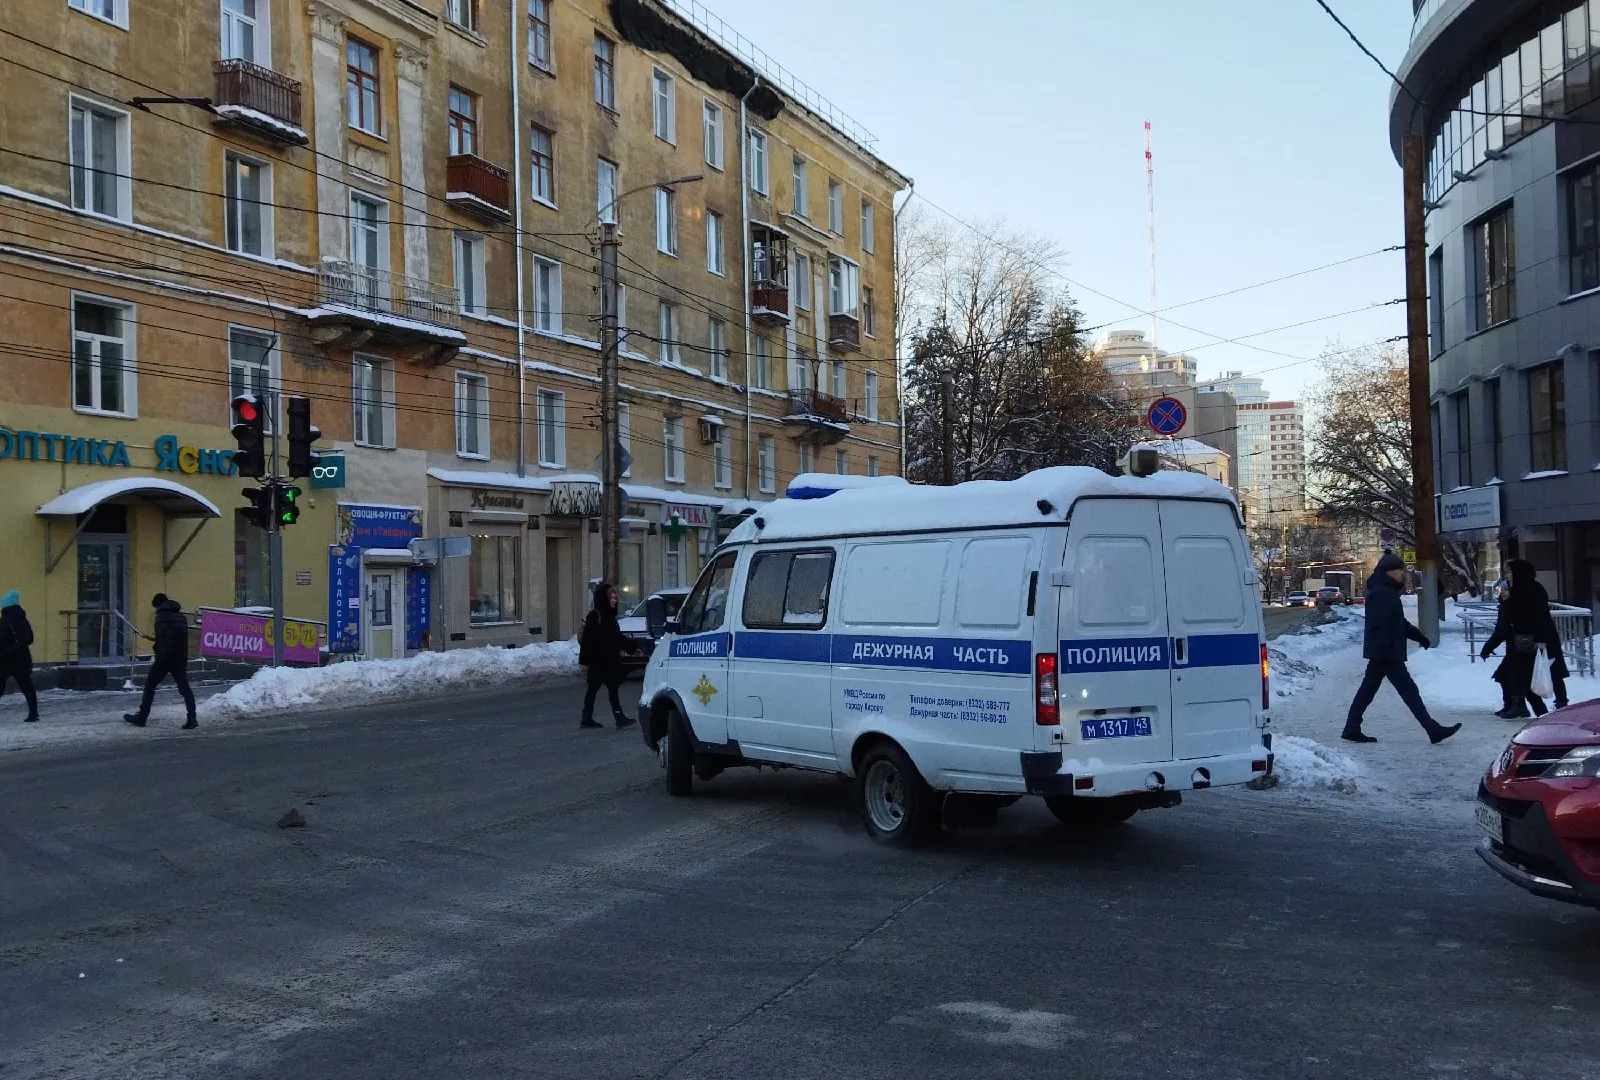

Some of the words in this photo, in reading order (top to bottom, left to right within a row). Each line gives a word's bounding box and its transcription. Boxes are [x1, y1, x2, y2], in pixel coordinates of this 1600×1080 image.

[0, 428, 130, 467] ОПТИКА
[204, 631, 263, 653] СКИДКИ
[676, 640, 718, 656] ПОЛИЦИЯ
[852, 641, 934, 661] ДЕЖУРНАЯ
[953, 645, 1010, 665] ЧАСТЬ
[1067, 645, 1161, 665] ПОЛИЦИЯ
[909, 694, 935, 705] Телефон
[909, 707, 938, 719] Дежурная
[1099, 719, 1128, 736] 1317
[1136, 717, 1148, 730] 43
